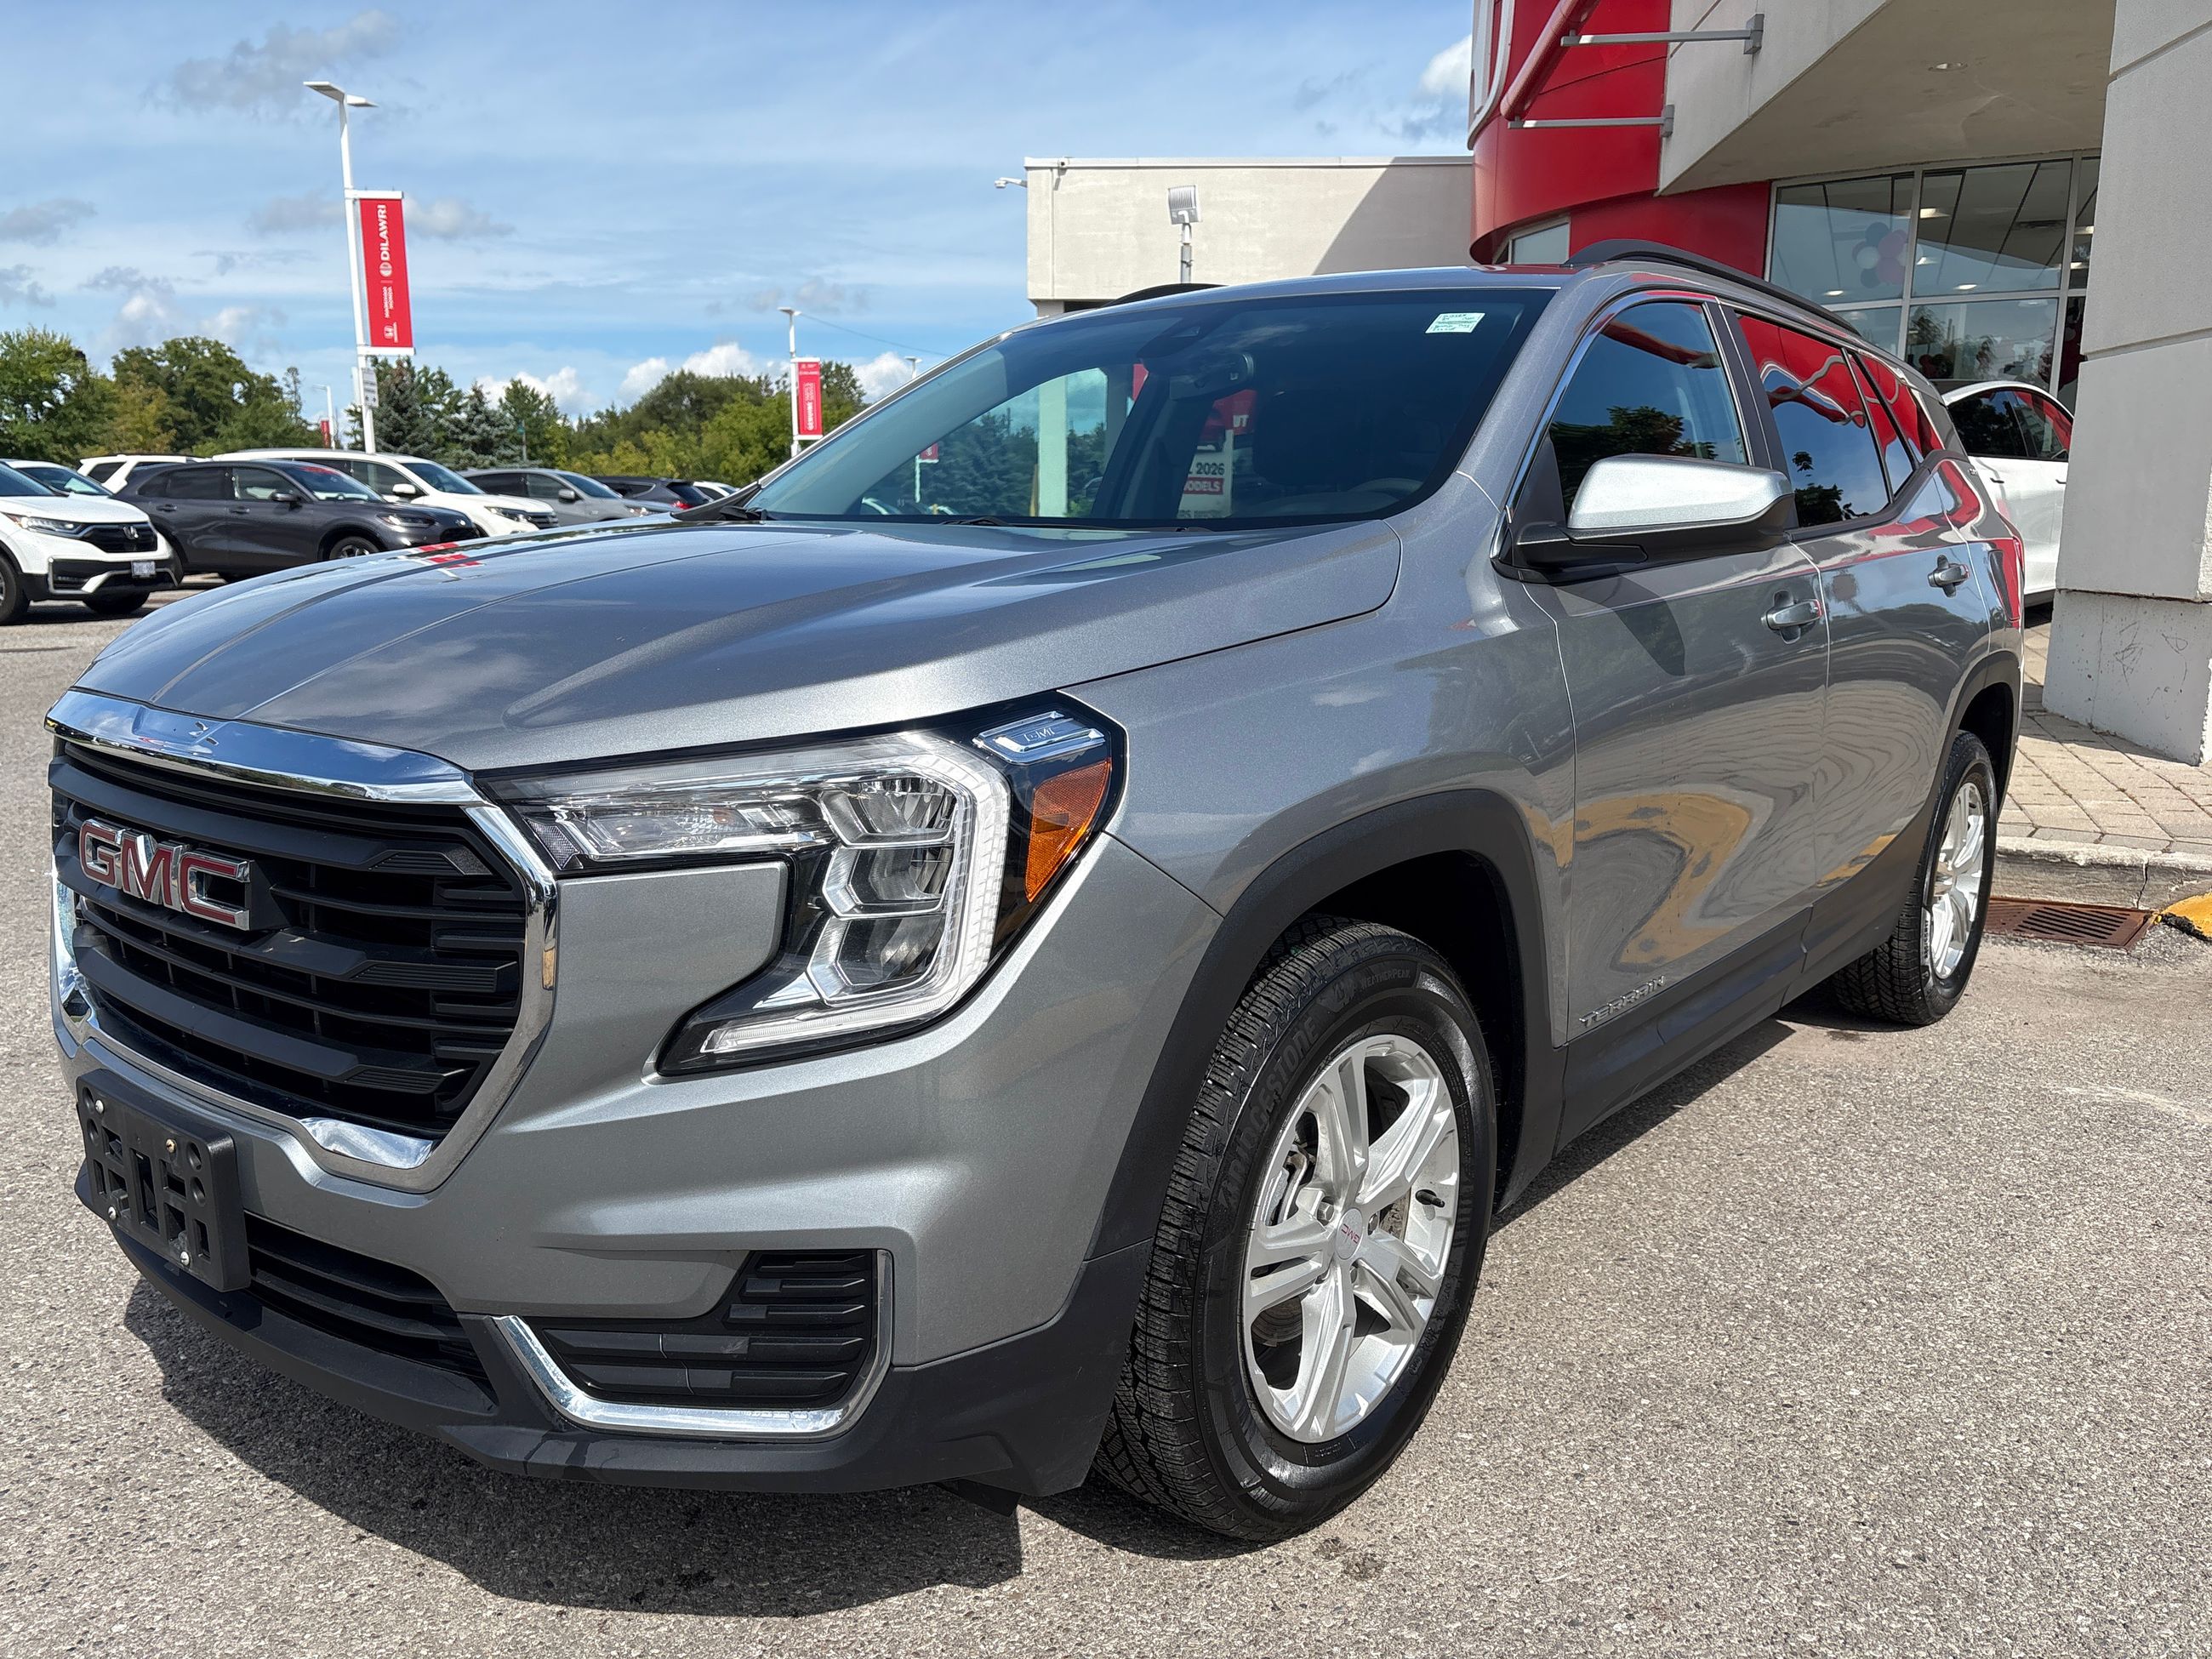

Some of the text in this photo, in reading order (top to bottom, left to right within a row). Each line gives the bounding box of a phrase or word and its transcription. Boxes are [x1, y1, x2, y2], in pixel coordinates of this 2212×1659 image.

[377, 204, 390, 260] DILAWRI
[1196, 462, 1225, 475] 2026
[80, 818, 253, 931] GMC
[1218, 1014, 1321, 1209] BRIDGESTONE
[1342, 1223, 1360, 1244] GMC
